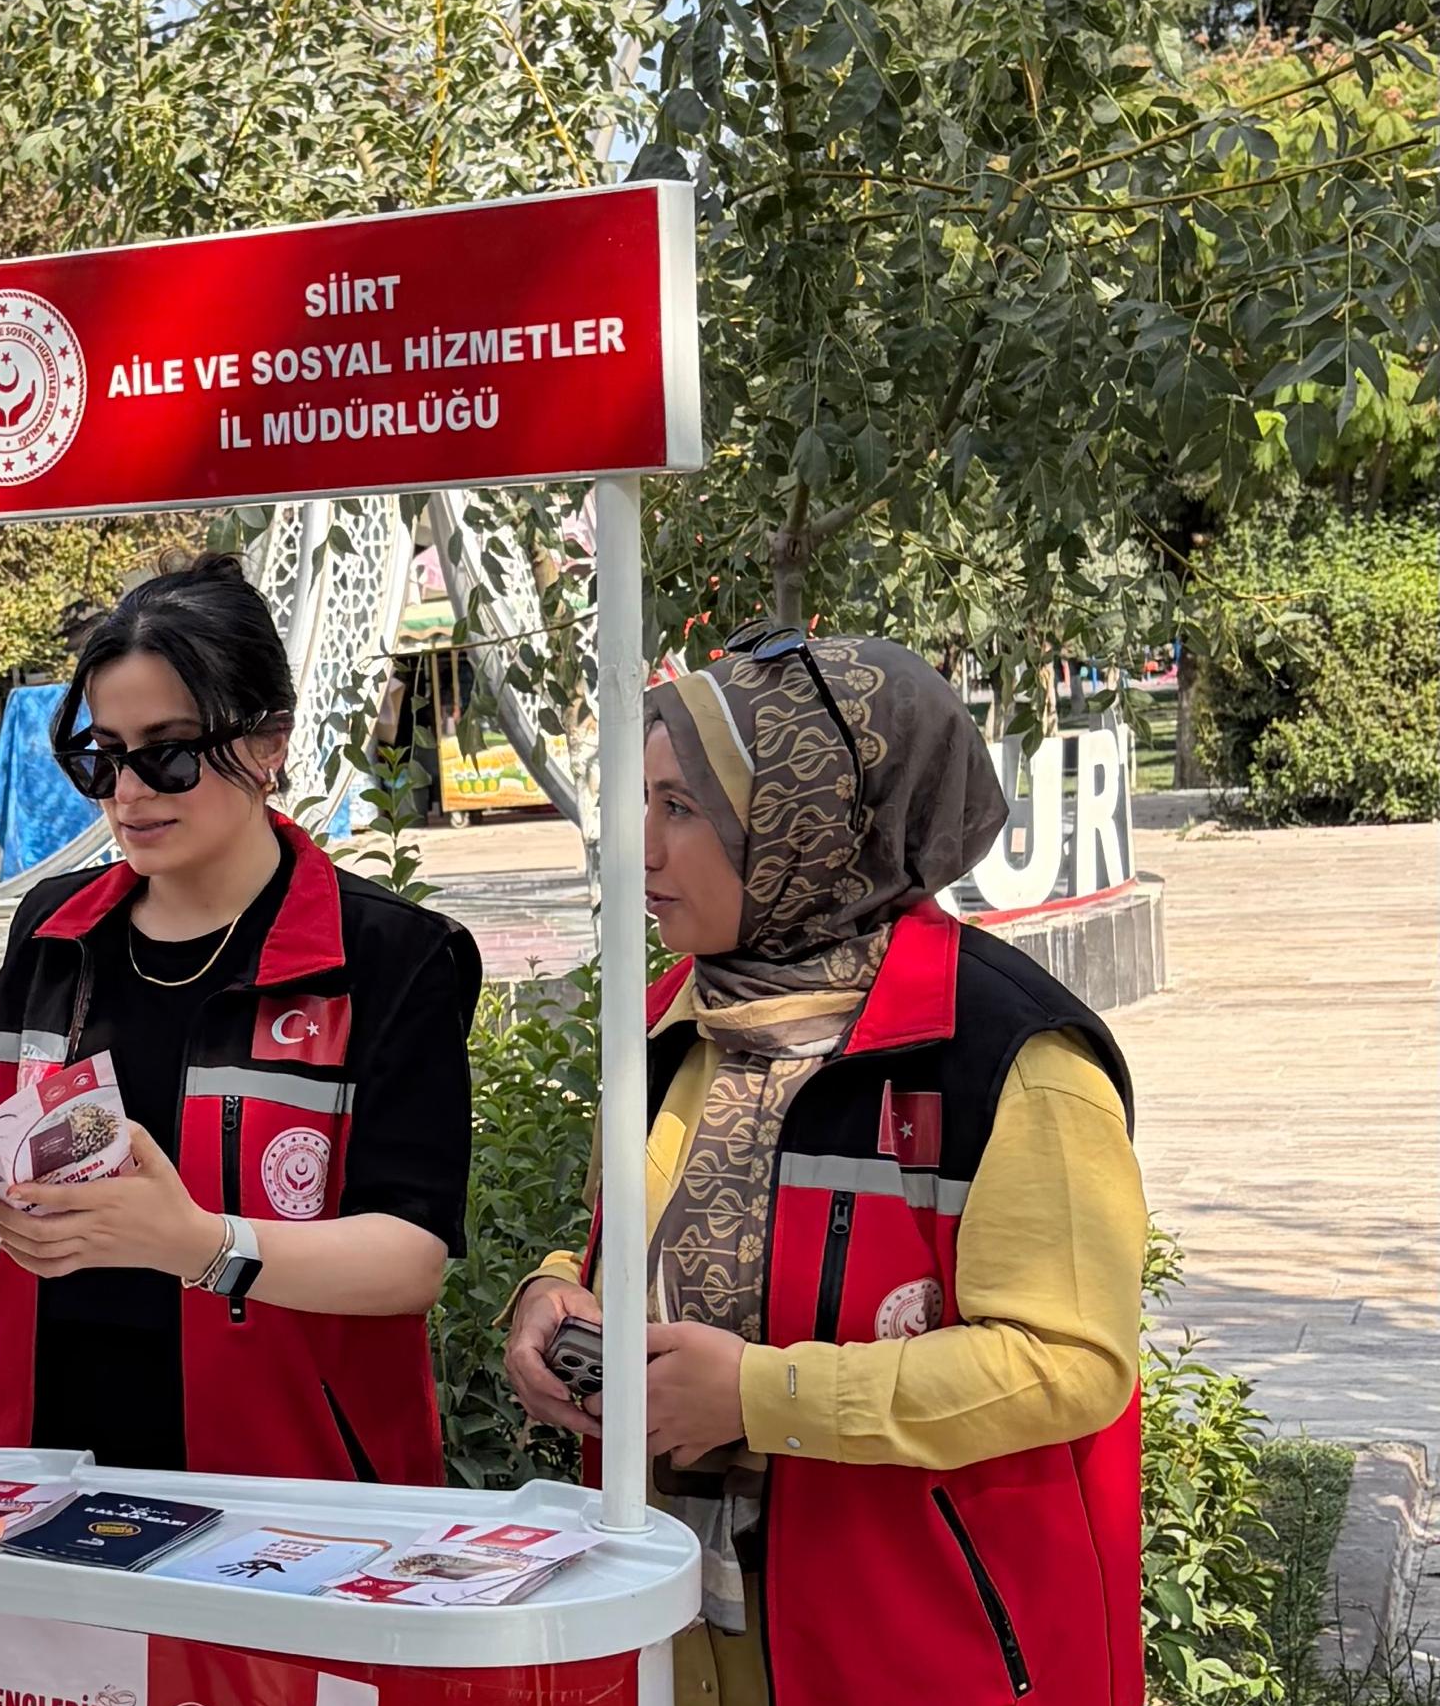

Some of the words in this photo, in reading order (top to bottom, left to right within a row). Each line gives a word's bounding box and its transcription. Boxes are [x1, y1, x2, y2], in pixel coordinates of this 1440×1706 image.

[304, 271, 401, 319] SİİRT
[107, 354, 184, 399] AİLE
[193, 353, 241, 391] VE
[251, 339, 393, 386] SOSYAL
[404, 315, 626, 372] HİZMETLER
[219, 407, 252, 450] İL
[262, 386, 500, 446] MÜDÜRLÜĞÜ
